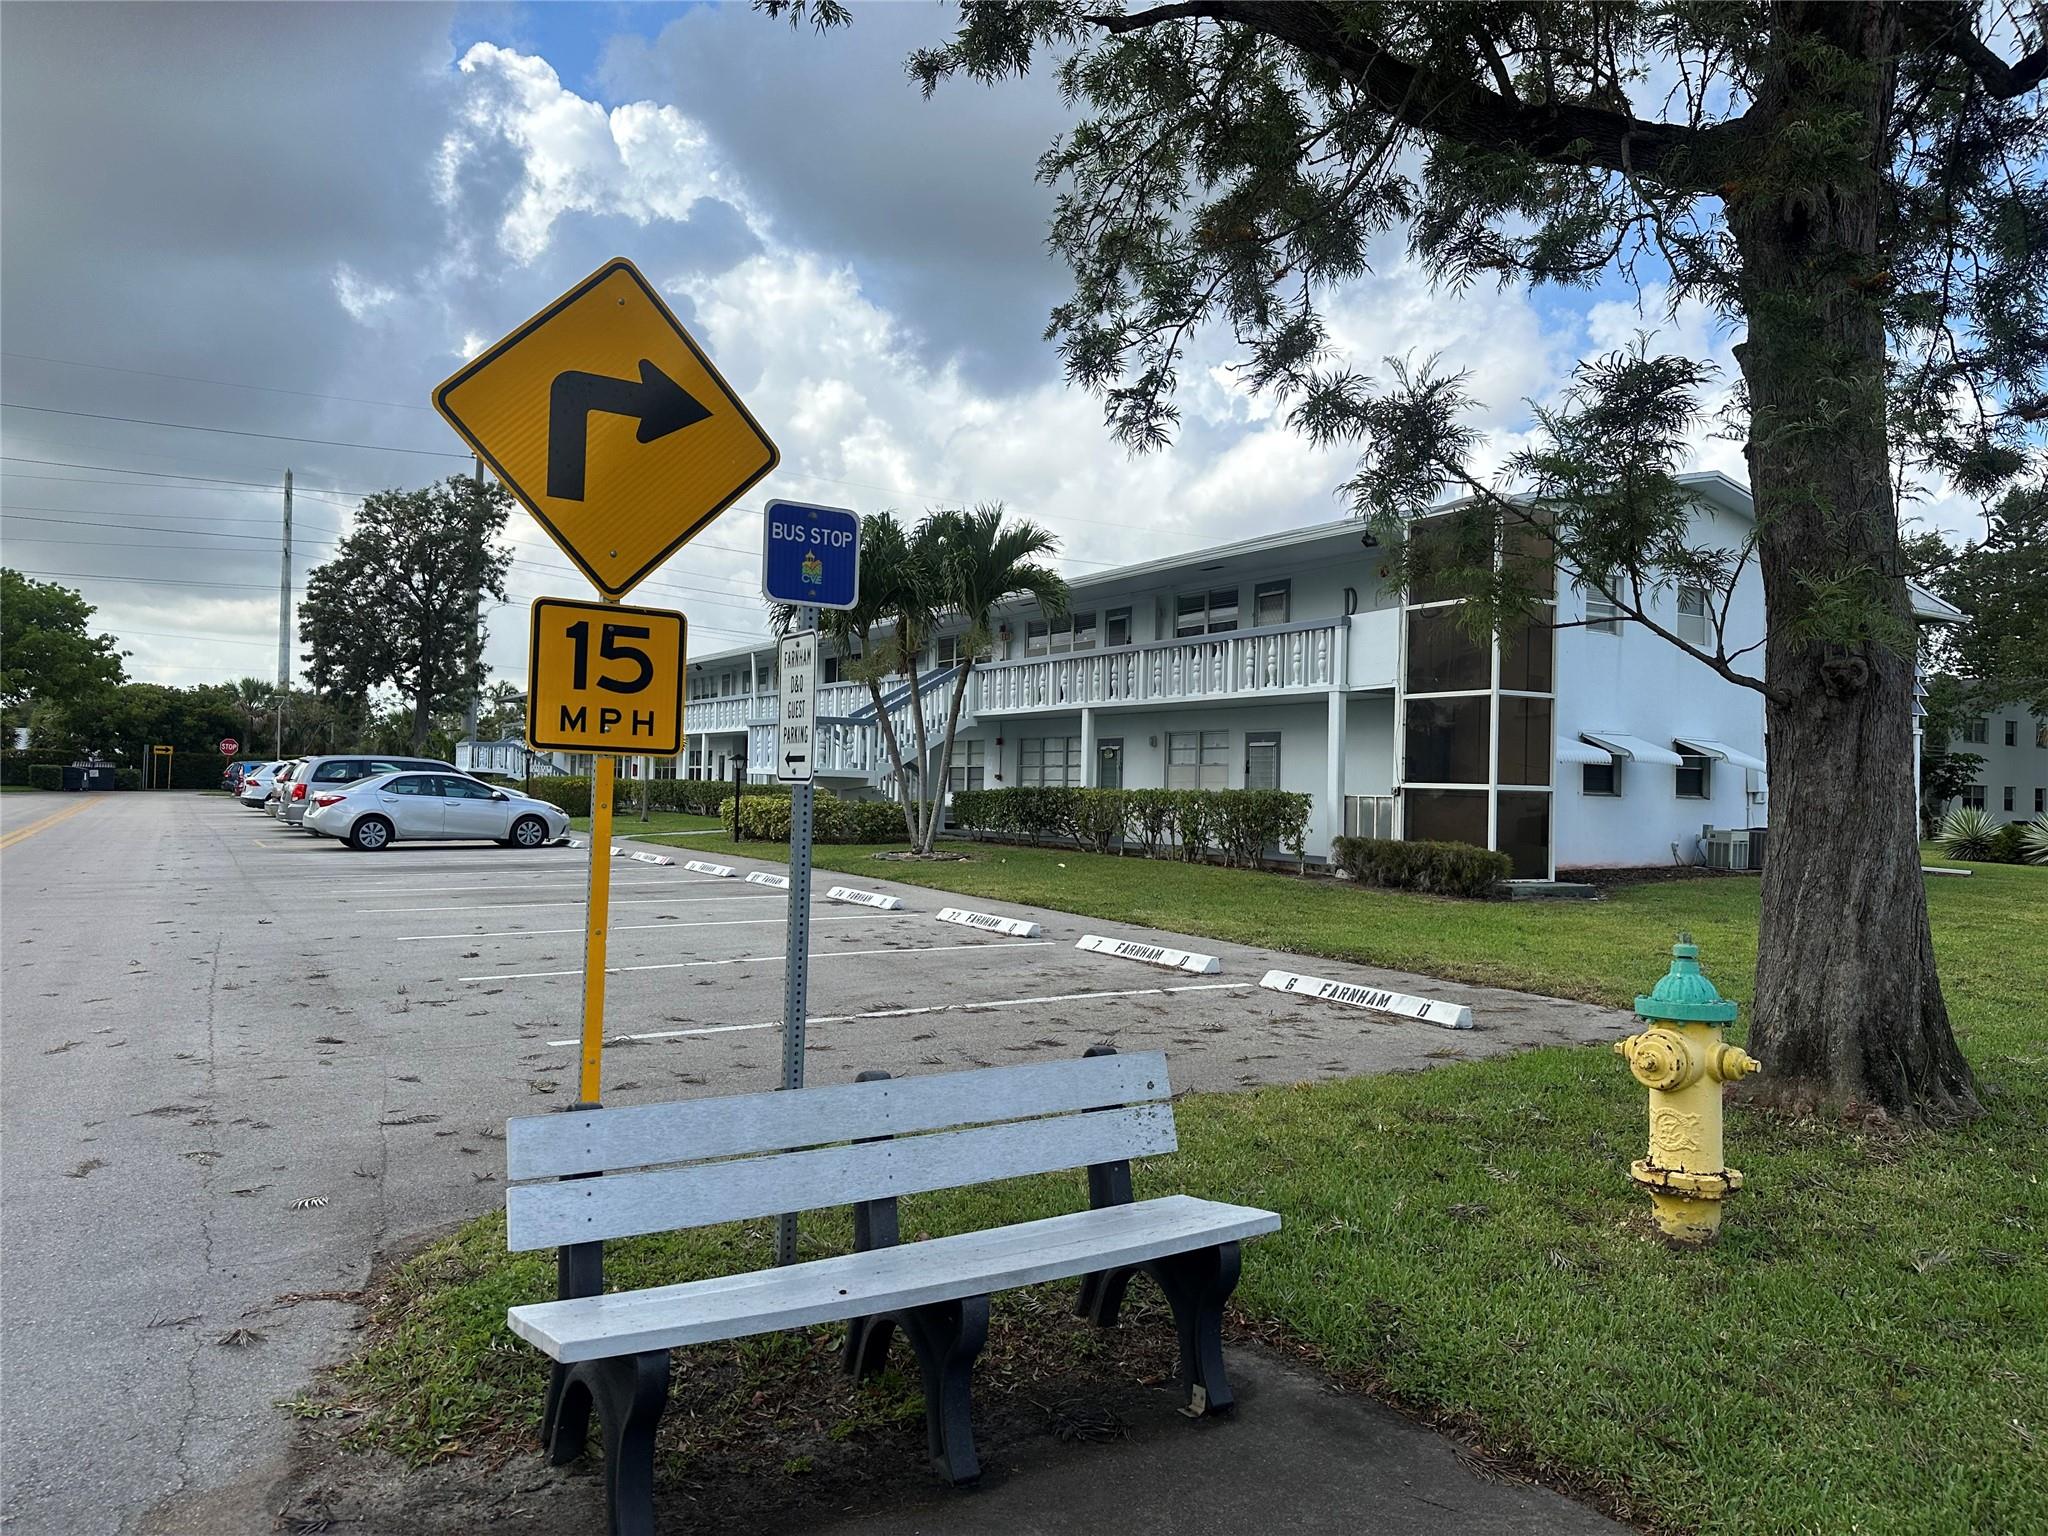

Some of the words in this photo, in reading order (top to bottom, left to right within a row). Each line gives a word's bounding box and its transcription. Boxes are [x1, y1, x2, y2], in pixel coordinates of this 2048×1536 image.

[772, 522, 806, 542] BUS
[810, 527, 853, 548] STOP
[801, 574, 823, 585] CVE
[1343, 587, 1358, 616] D
[566, 621, 654, 694] 15
[784, 647, 812, 669] FARNHAM
[787, 700, 806, 719] GUEST
[560, 705, 654, 736] MPH
[783, 725, 809, 744] PARKING
[221, 743, 237, 751] STOP
[966, 913, 1002, 929] FARNHAM
[1093, 940, 1103, 950] 7
[1114, 942, 1165, 960] FARNHAM
[1318, 983, 1392, 1008] FARNHAM
